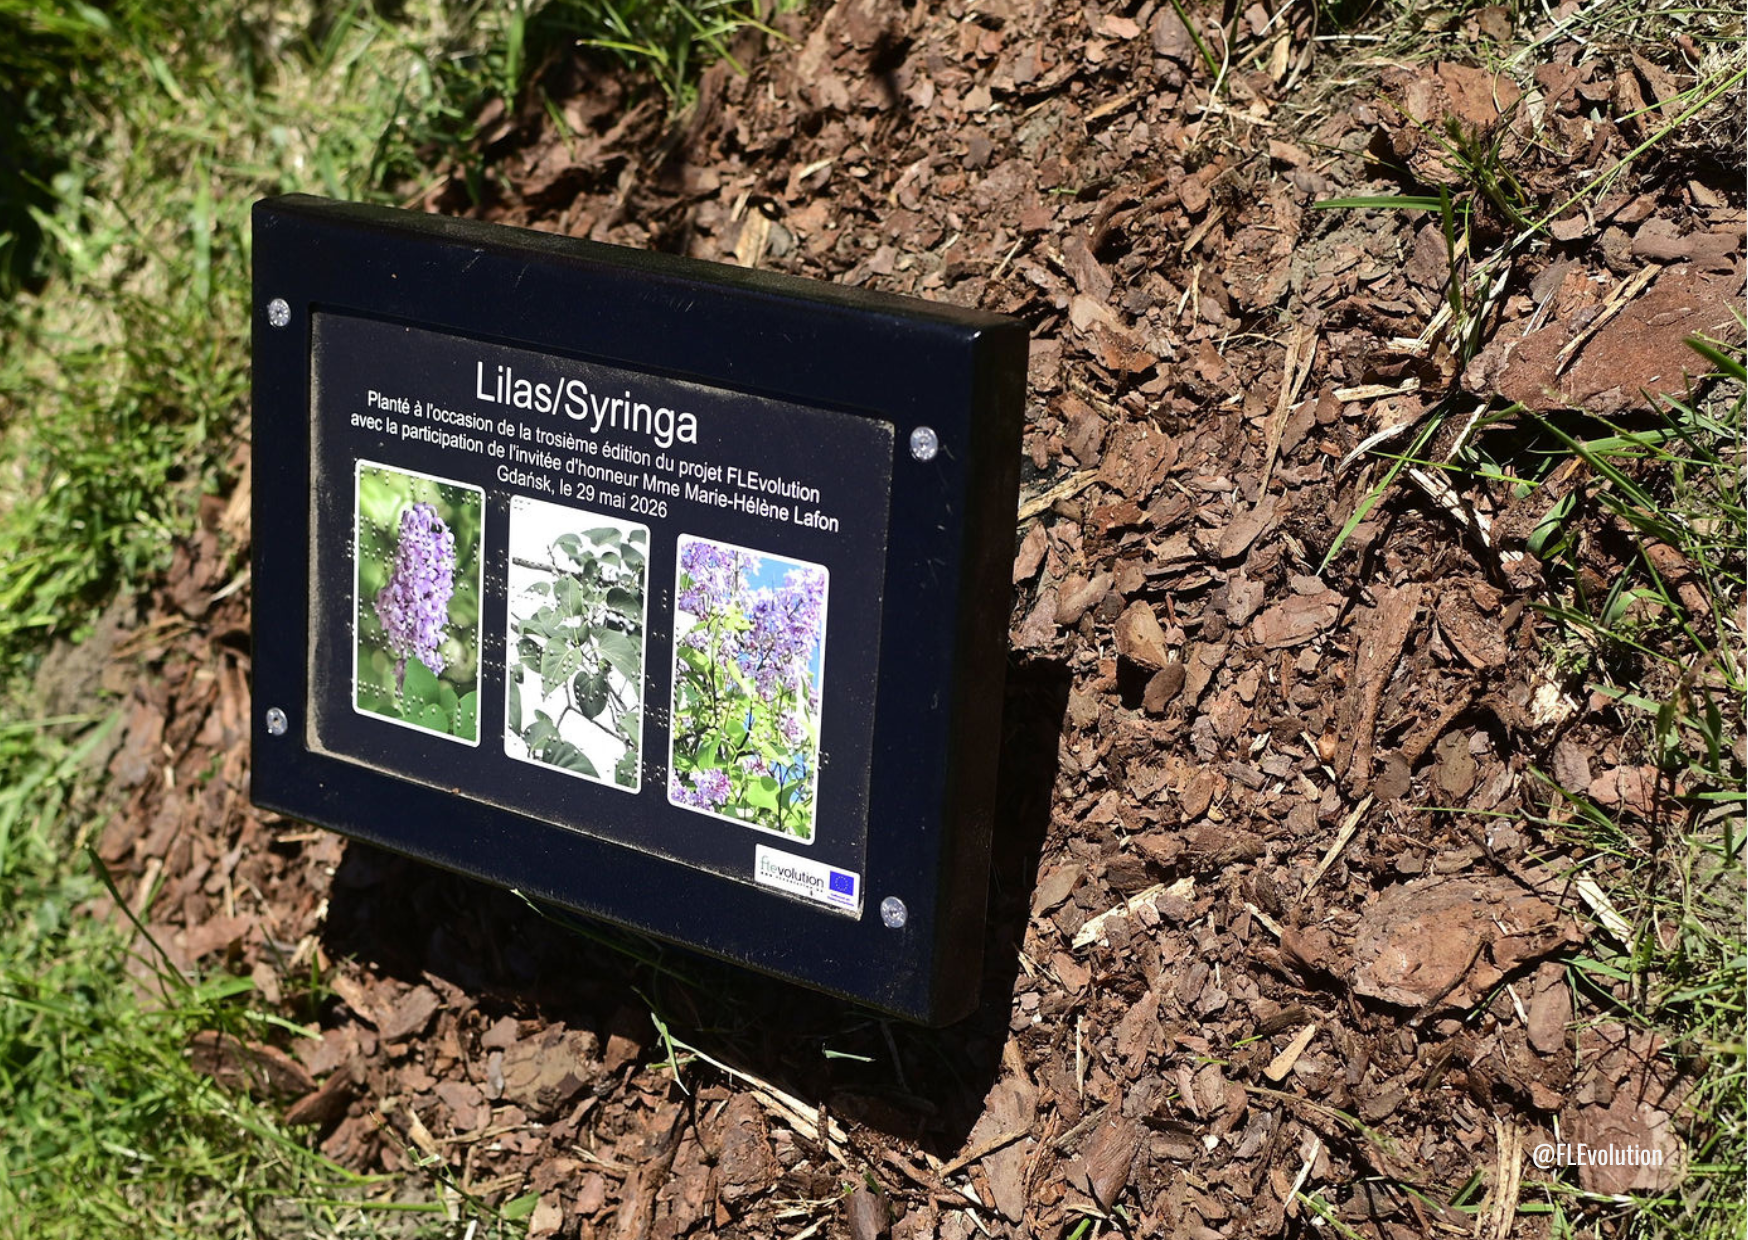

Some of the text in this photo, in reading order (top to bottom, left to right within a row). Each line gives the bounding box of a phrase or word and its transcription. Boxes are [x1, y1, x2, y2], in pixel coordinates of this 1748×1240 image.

[368, 390, 821, 504] Planté à l'occasion de la trosième édition du projet FLEvolution
[477, 361, 698, 449] Lilas/Syringa
[350, 412, 840, 533] avec la participation de l'invitée d'honneur Mme Marie-Hélène Lafon
[496, 465, 668, 519] Gdańsk, le 29 mai 2026
